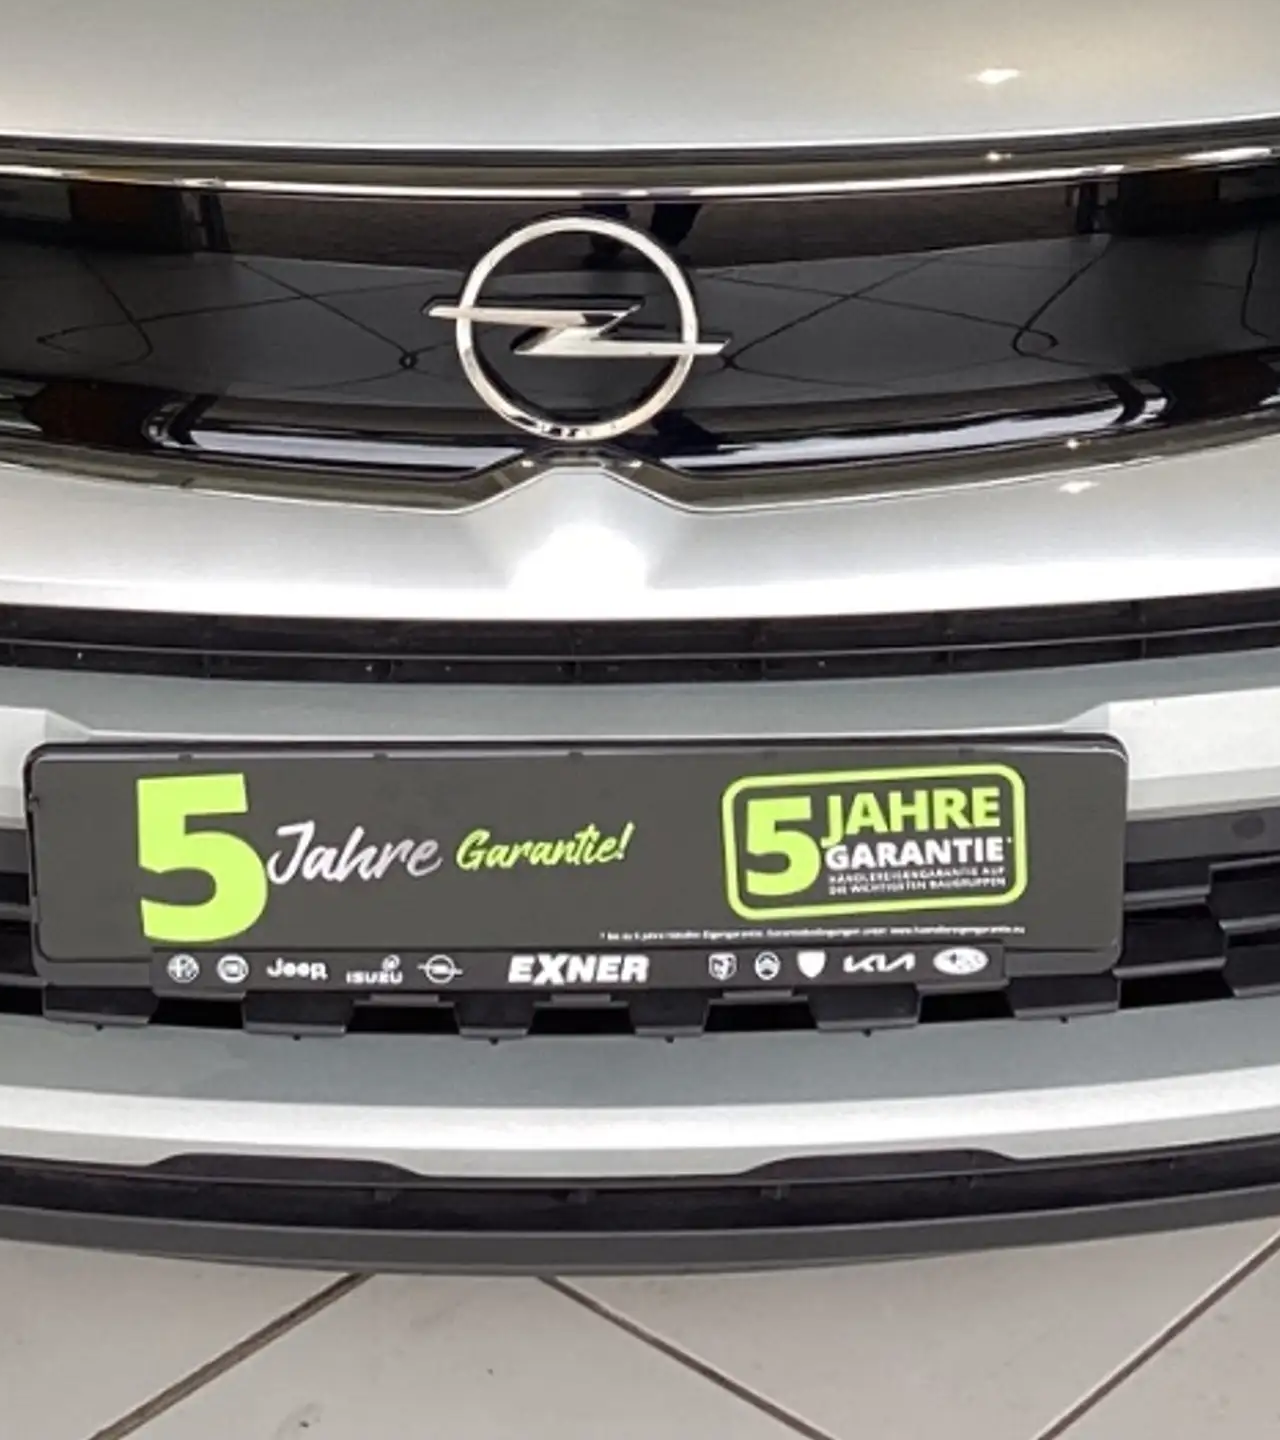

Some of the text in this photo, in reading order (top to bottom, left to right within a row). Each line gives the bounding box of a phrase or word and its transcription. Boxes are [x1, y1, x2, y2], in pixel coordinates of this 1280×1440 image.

[137, 772, 636, 942] 5 Jahre Garantie!
[745, 787, 1002, 897] 5 JAHRE
[824, 836, 1005, 871] GARANTIE
[266, 956, 329, 981] Jeep
[506, 952, 651, 986] EXNER
